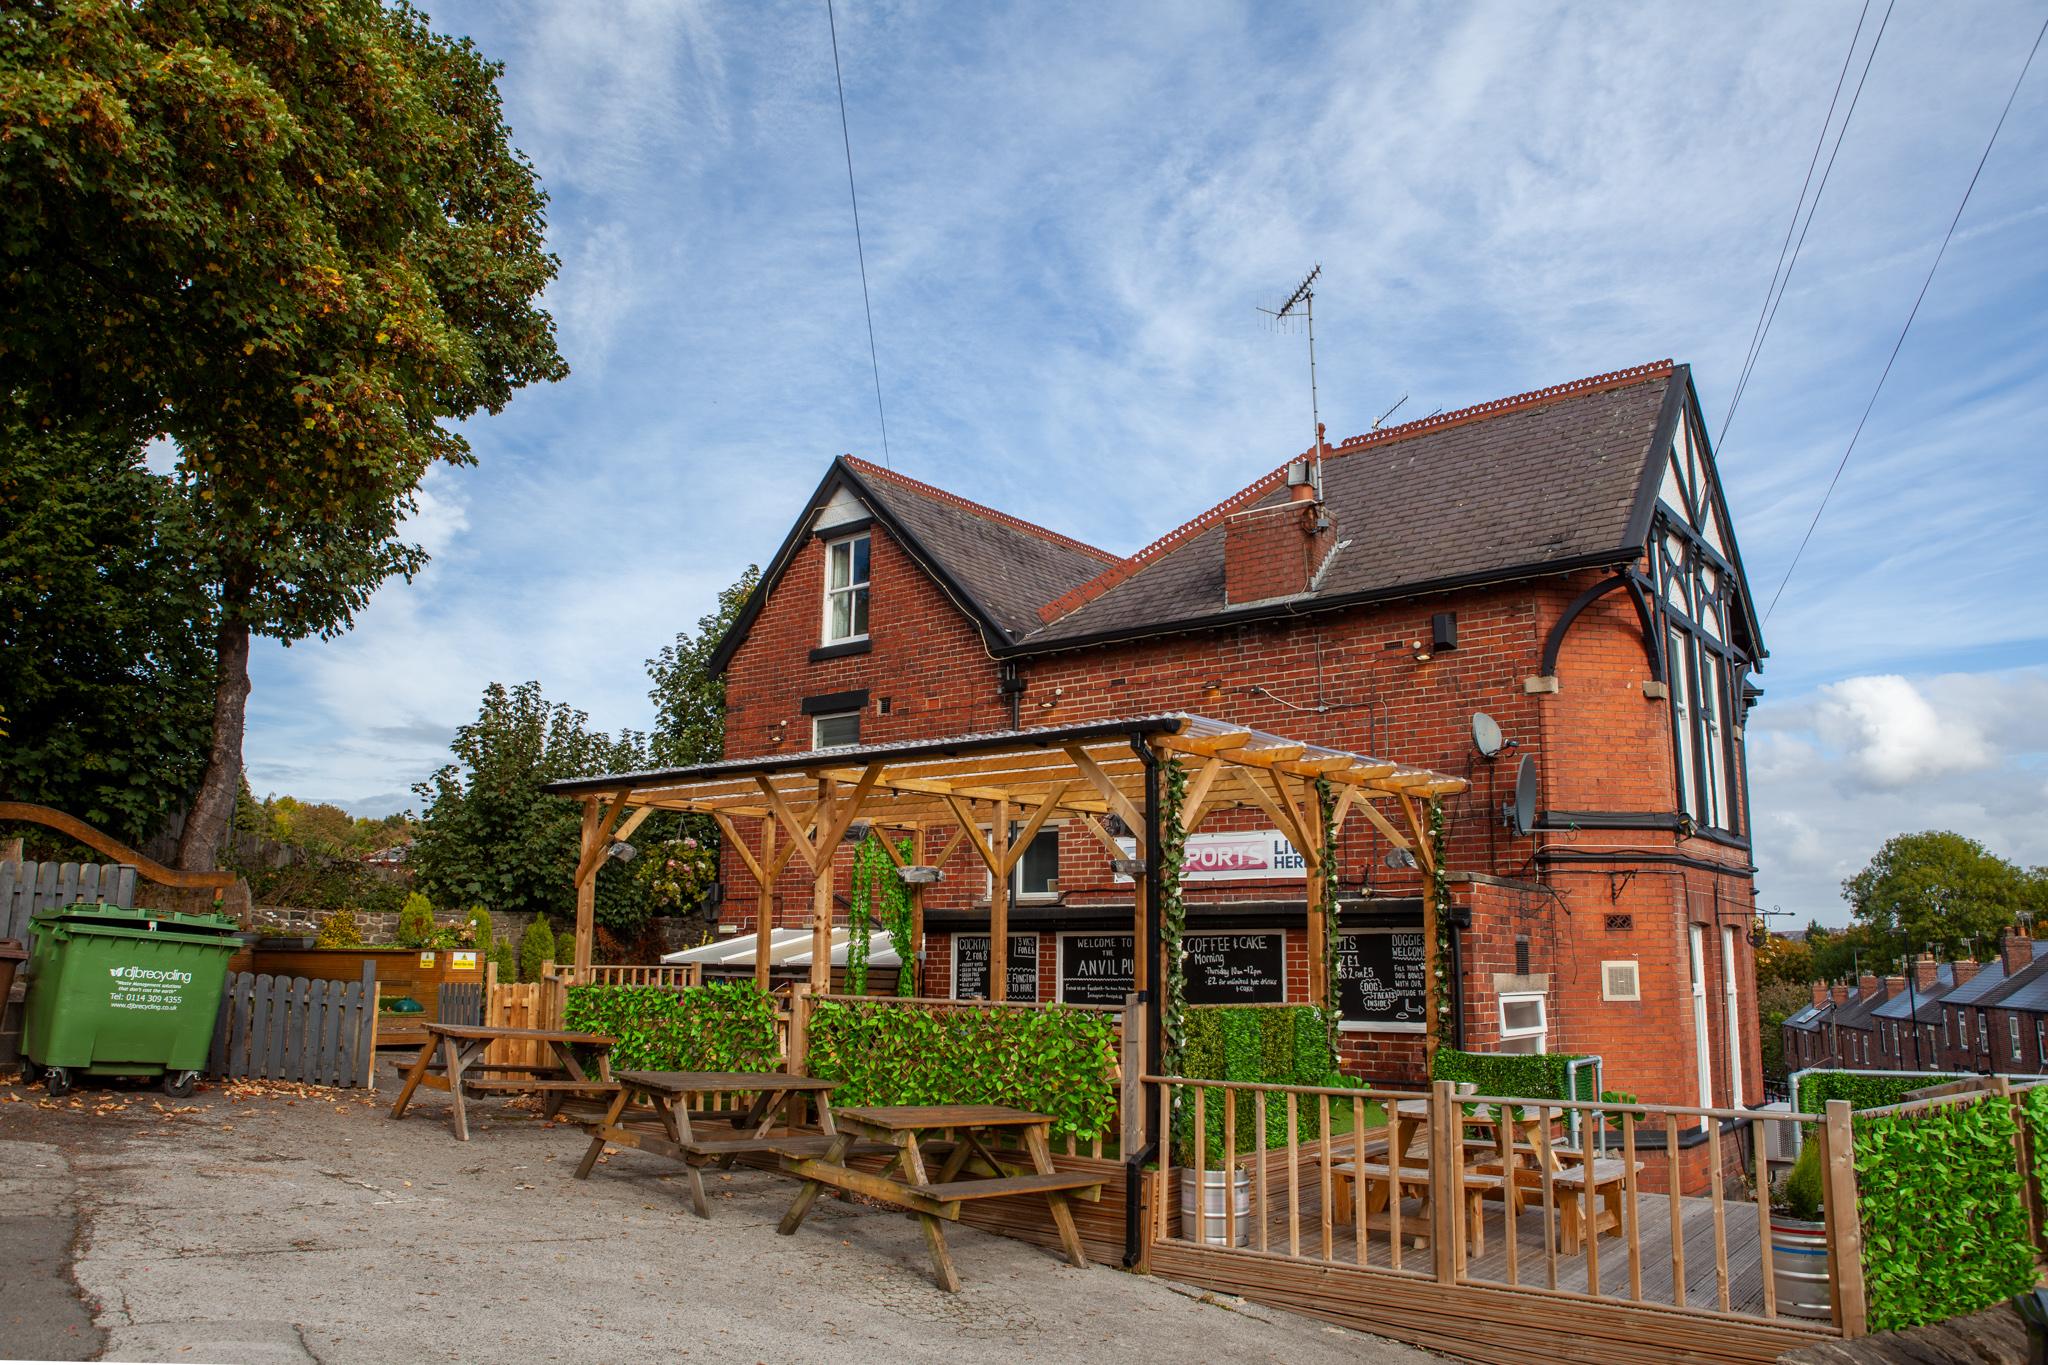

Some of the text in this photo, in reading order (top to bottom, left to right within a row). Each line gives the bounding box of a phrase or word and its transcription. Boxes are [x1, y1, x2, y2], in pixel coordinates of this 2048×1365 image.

[1274, 840, 1298, 854] LIV
[1180, 845, 1265, 867] PORTS
[1078, 938, 1132, 948] WELCOME TO
[1187, 937, 1230, 953] COFFEE
[1240, 936, 1268, 949] CAKE
[966, 950, 972, 960] 2
[983, 950, 988, 960] 8
[1194, 953, 1224, 967] Morning
[1078, 958, 1134, 976] ANVIL PU
[1348, 967, 1355, 979] 2
[124, 966, 192, 984] djbrecycling
[1012, 984, 1019, 993] TO
[1020, 984, 1034, 992] HIRE
[1364, 982, 1378, 991] DOG
[126, 993, 146, 1002] 0114
[147, 994, 162, 1003] 309
[111, 1002, 177, 1011] www.djbrecycling.co.uk
